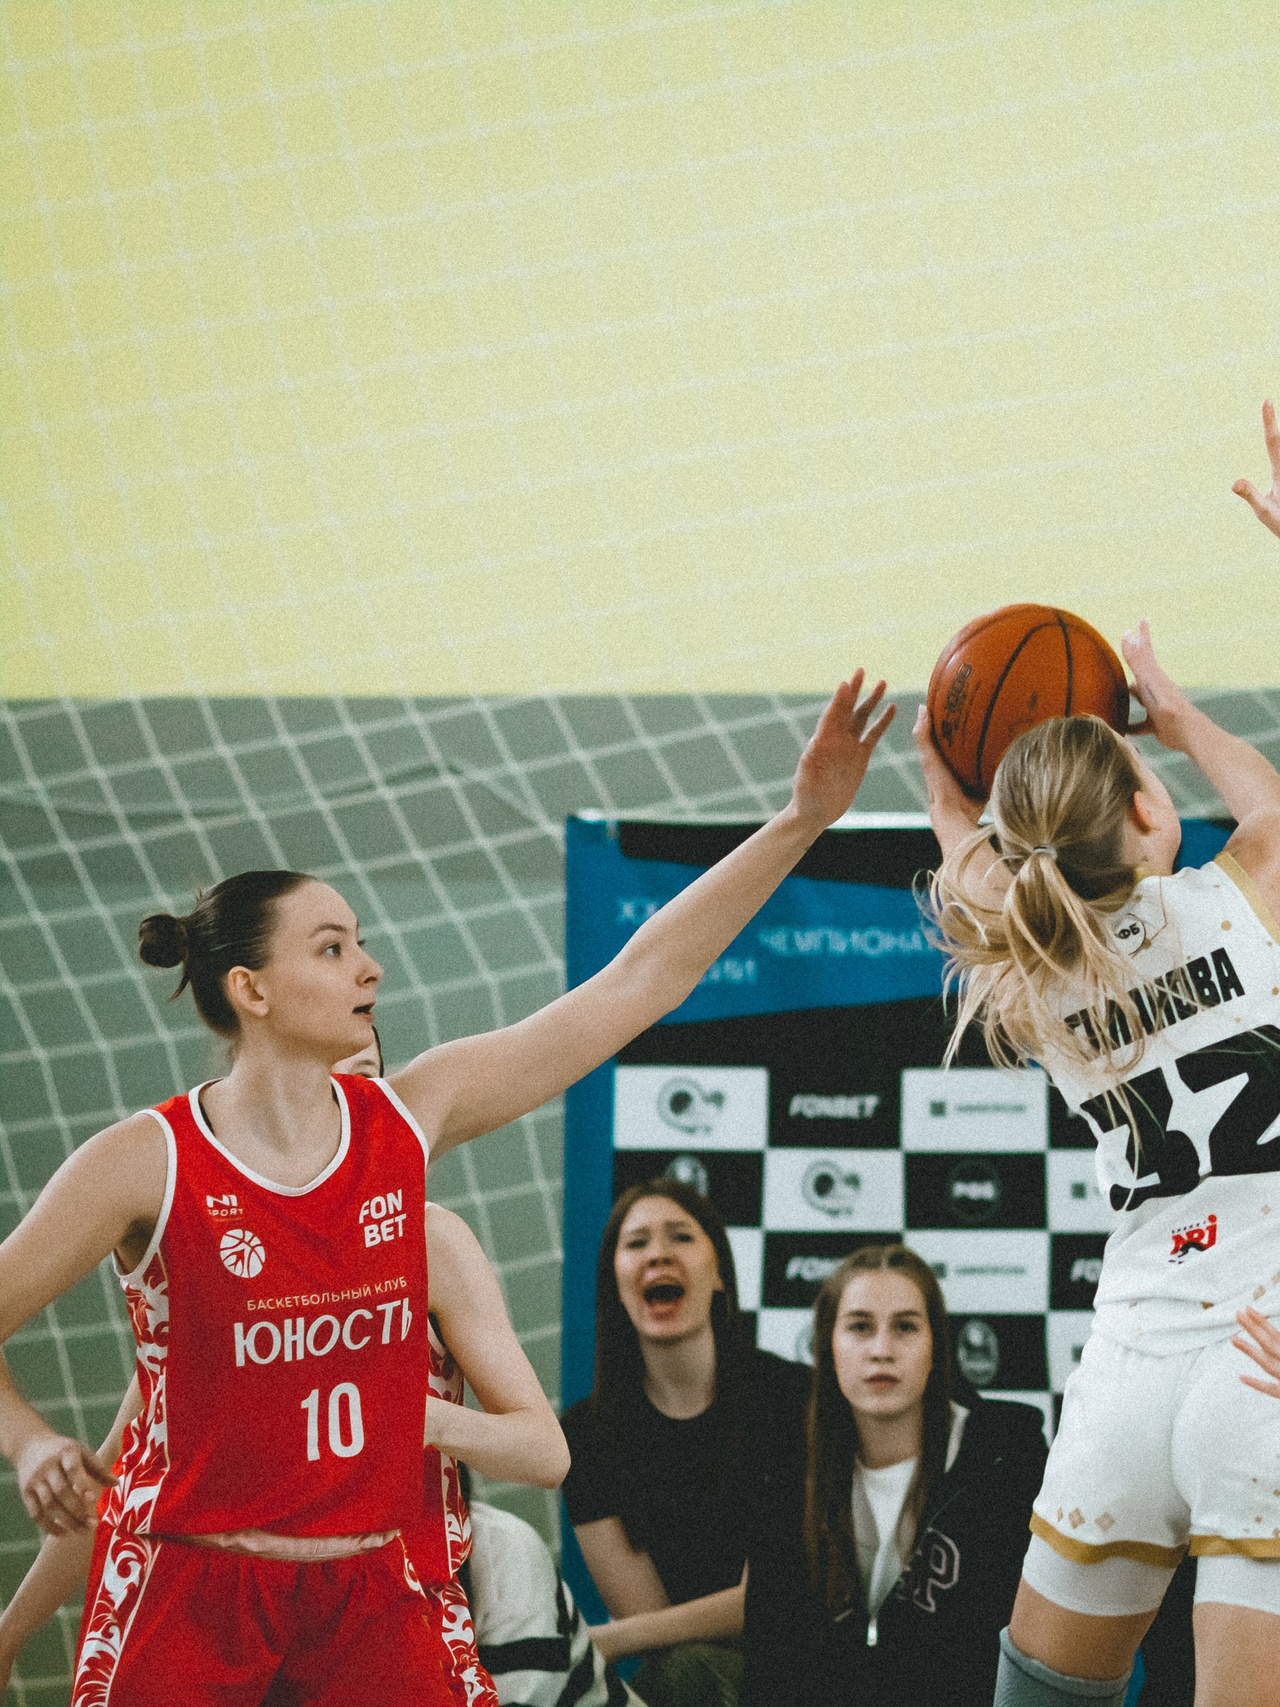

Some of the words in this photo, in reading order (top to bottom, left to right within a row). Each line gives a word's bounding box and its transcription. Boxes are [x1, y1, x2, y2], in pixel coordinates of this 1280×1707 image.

[359, 1189, 402, 1224] FON
[364, 1213, 407, 1248] BET
[247, 1283, 372, 1311] БАСКЕТБОЛЬНЫЙ
[374, 1276, 408, 1295] КЛУБ
[300, 1382, 365, 1462] 10
